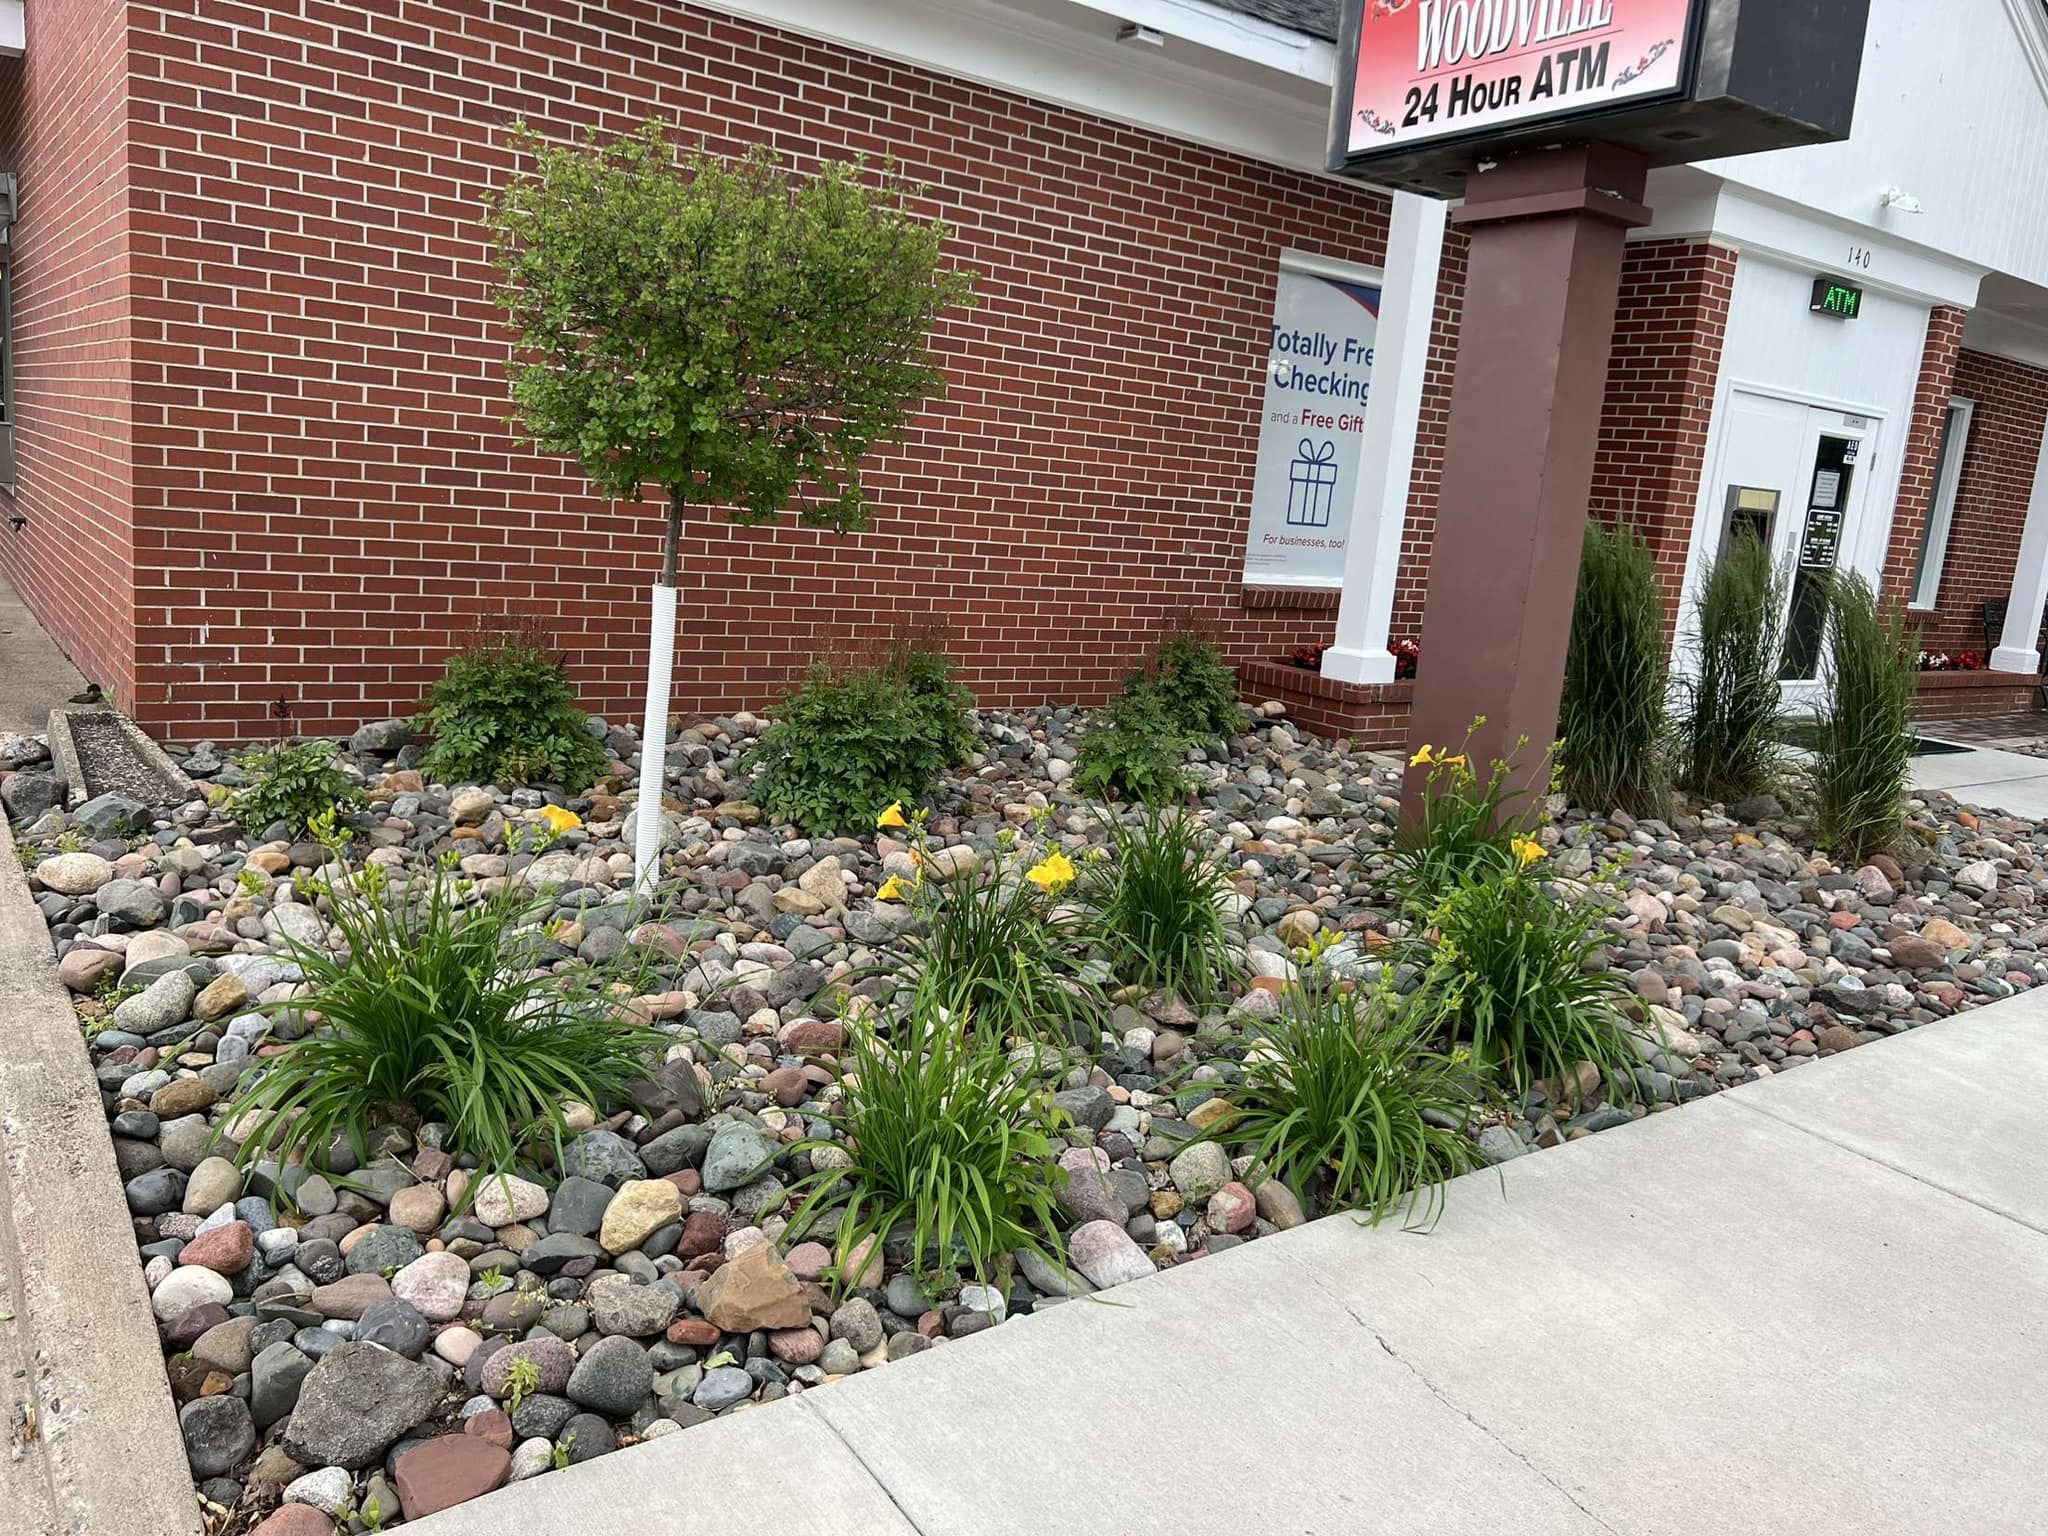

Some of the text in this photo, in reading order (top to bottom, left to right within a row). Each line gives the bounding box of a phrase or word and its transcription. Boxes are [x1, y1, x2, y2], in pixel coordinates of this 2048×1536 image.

[1402, 82, 1439, 127] 24
[1529, 41, 1610, 101] ATM
[1848, 246, 1870, 269] 140
[1823, 286, 1857, 314] ATM
[1270, 324, 1338, 366] Totally
[1274, 364, 1369, 407] Checking
[1271, 408, 1364, 433] and a Free Gift
[1263, 533, 1345, 550] For businesses, too!
